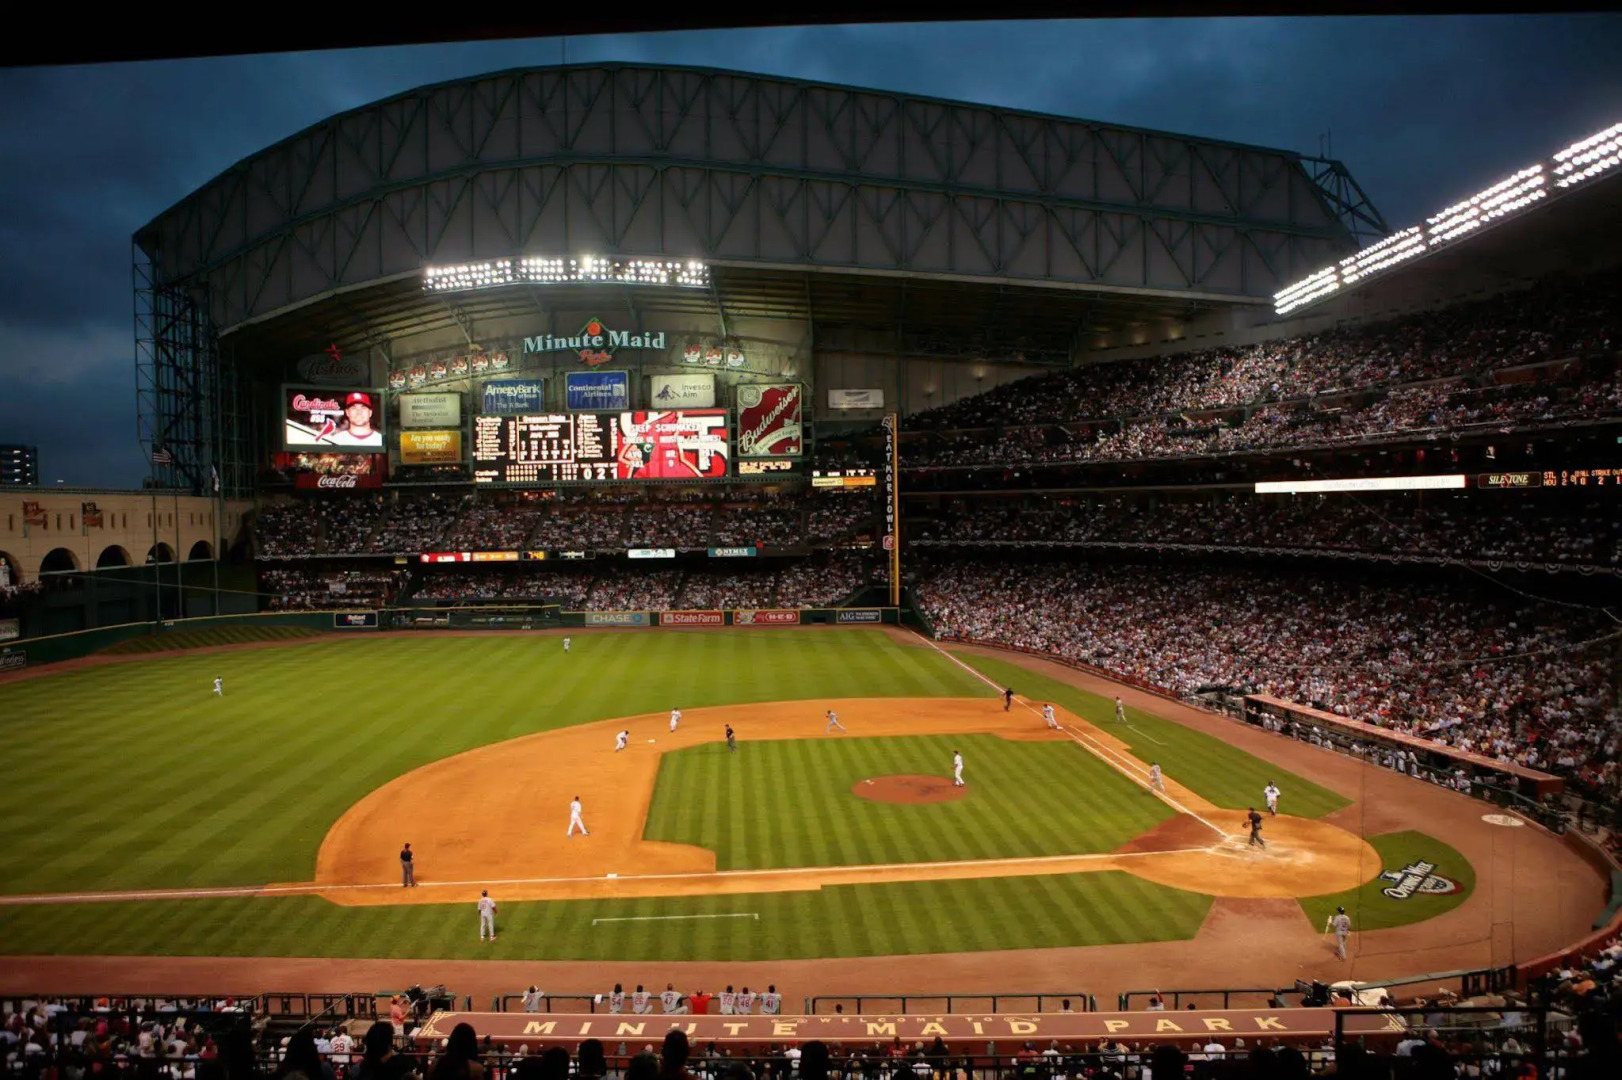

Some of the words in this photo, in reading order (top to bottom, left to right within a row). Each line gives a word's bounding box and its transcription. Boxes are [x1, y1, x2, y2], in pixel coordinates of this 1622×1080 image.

[523, 333, 603, 353] Minute
[609, 330, 665, 349] Maid
[292, 394, 340, 412] Cardinals
[739, 385, 799, 452] Budweiser
[584, 468, 592, 480] 0
[597, 468, 605, 479] 2
[611, 468, 618, 479] 1
[1598, 476, 1604, 485] 2
[1616, 476, 1621, 484] 1
[593, 614, 630, 622] CHASE
[741, 999, 750, 1007] 48
[866, 1021, 1038, 1036] MAID
[1104, 1016, 1289, 1034] PARK
[334, 1042, 344, 1052] 29
